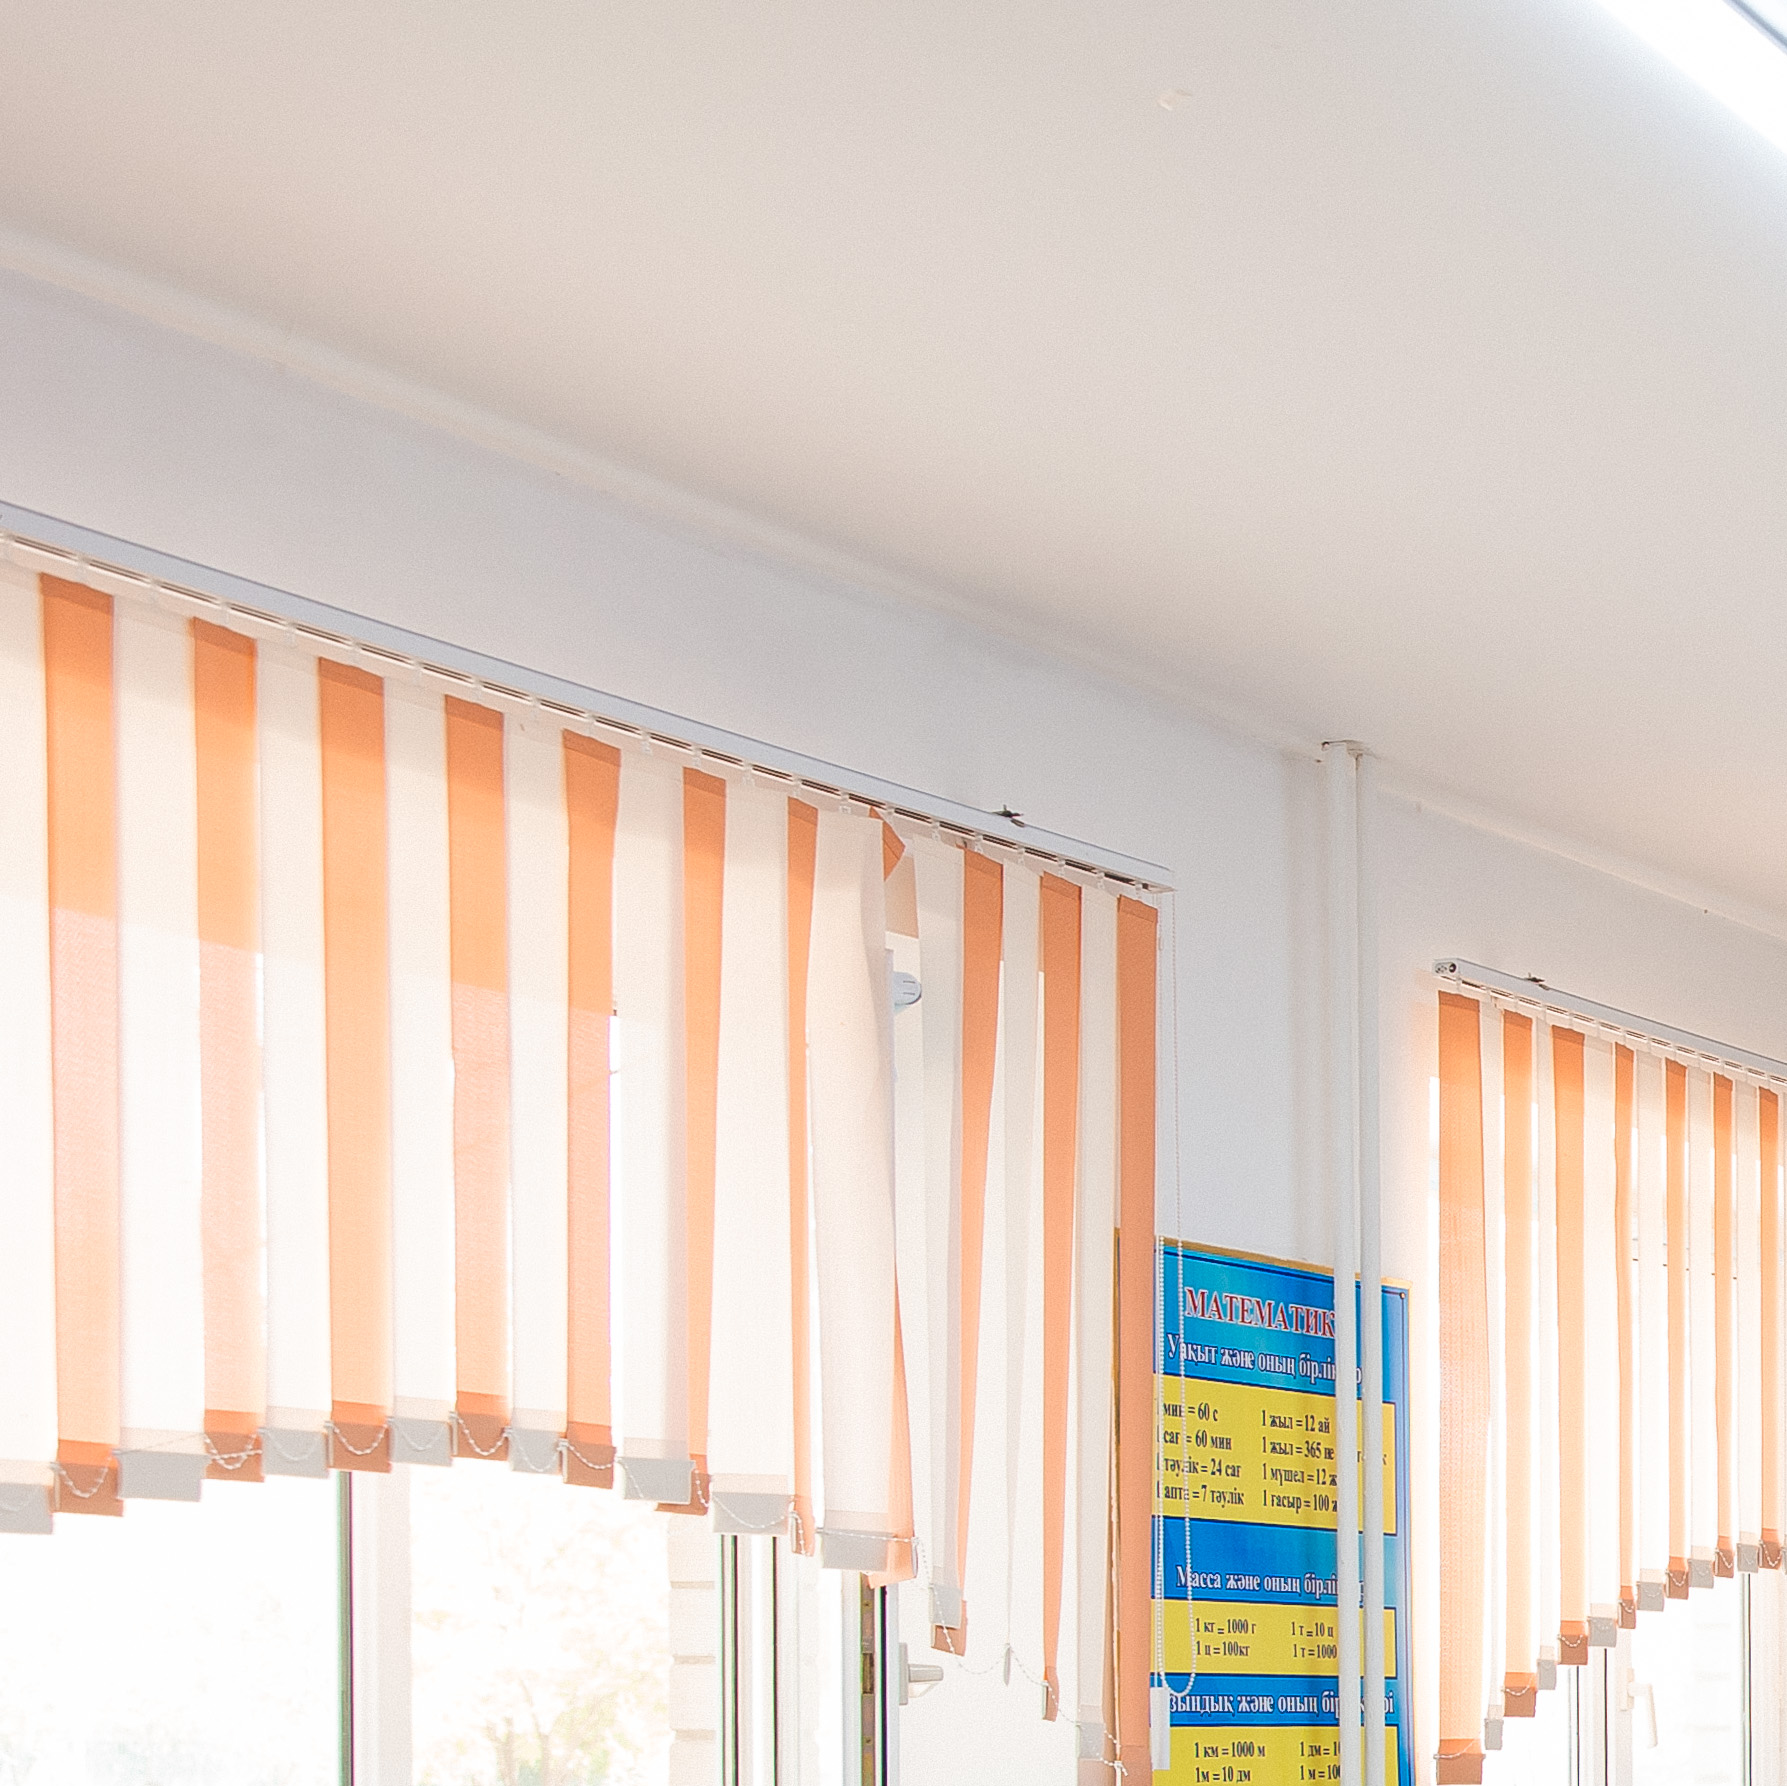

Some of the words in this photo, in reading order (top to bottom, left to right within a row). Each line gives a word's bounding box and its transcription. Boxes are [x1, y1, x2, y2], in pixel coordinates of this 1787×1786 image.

[1184, 1287, 1336, 1338] МАТЕМАТИК
[1221, 1348, 1254, 1369] және
[1258, 1353, 1295, 1376] оның
[1269, 1415, 1293, 1429] жыл
[1304, 1414, 1315, 1432] 12
[1318, 1417, 1330, 1433] ай
[1313, 1494, 1330, 1511] 100
[1176, 1566, 1221, 1589] Масса
[1226, 1574, 1260, 1591] және
[1264, 1576, 1300, 1596] оның
[1204, 1622, 1215, 1633] кг
[1227, 1619, 1248, 1634] 1000
[1170, 1696, 1234, 1717] зындық
[1237, 1695, 1274, 1713] және
[1278, 1696, 1318, 1717] оның
[1203, 1745, 1219, 1758] км
[1231, 1742, 1255, 1758] 1000
[1257, 1744, 1266, 1757] м
[1222, 1766, 1234, 1781] 10
[1236, 1769, 1251, 1783] дм
